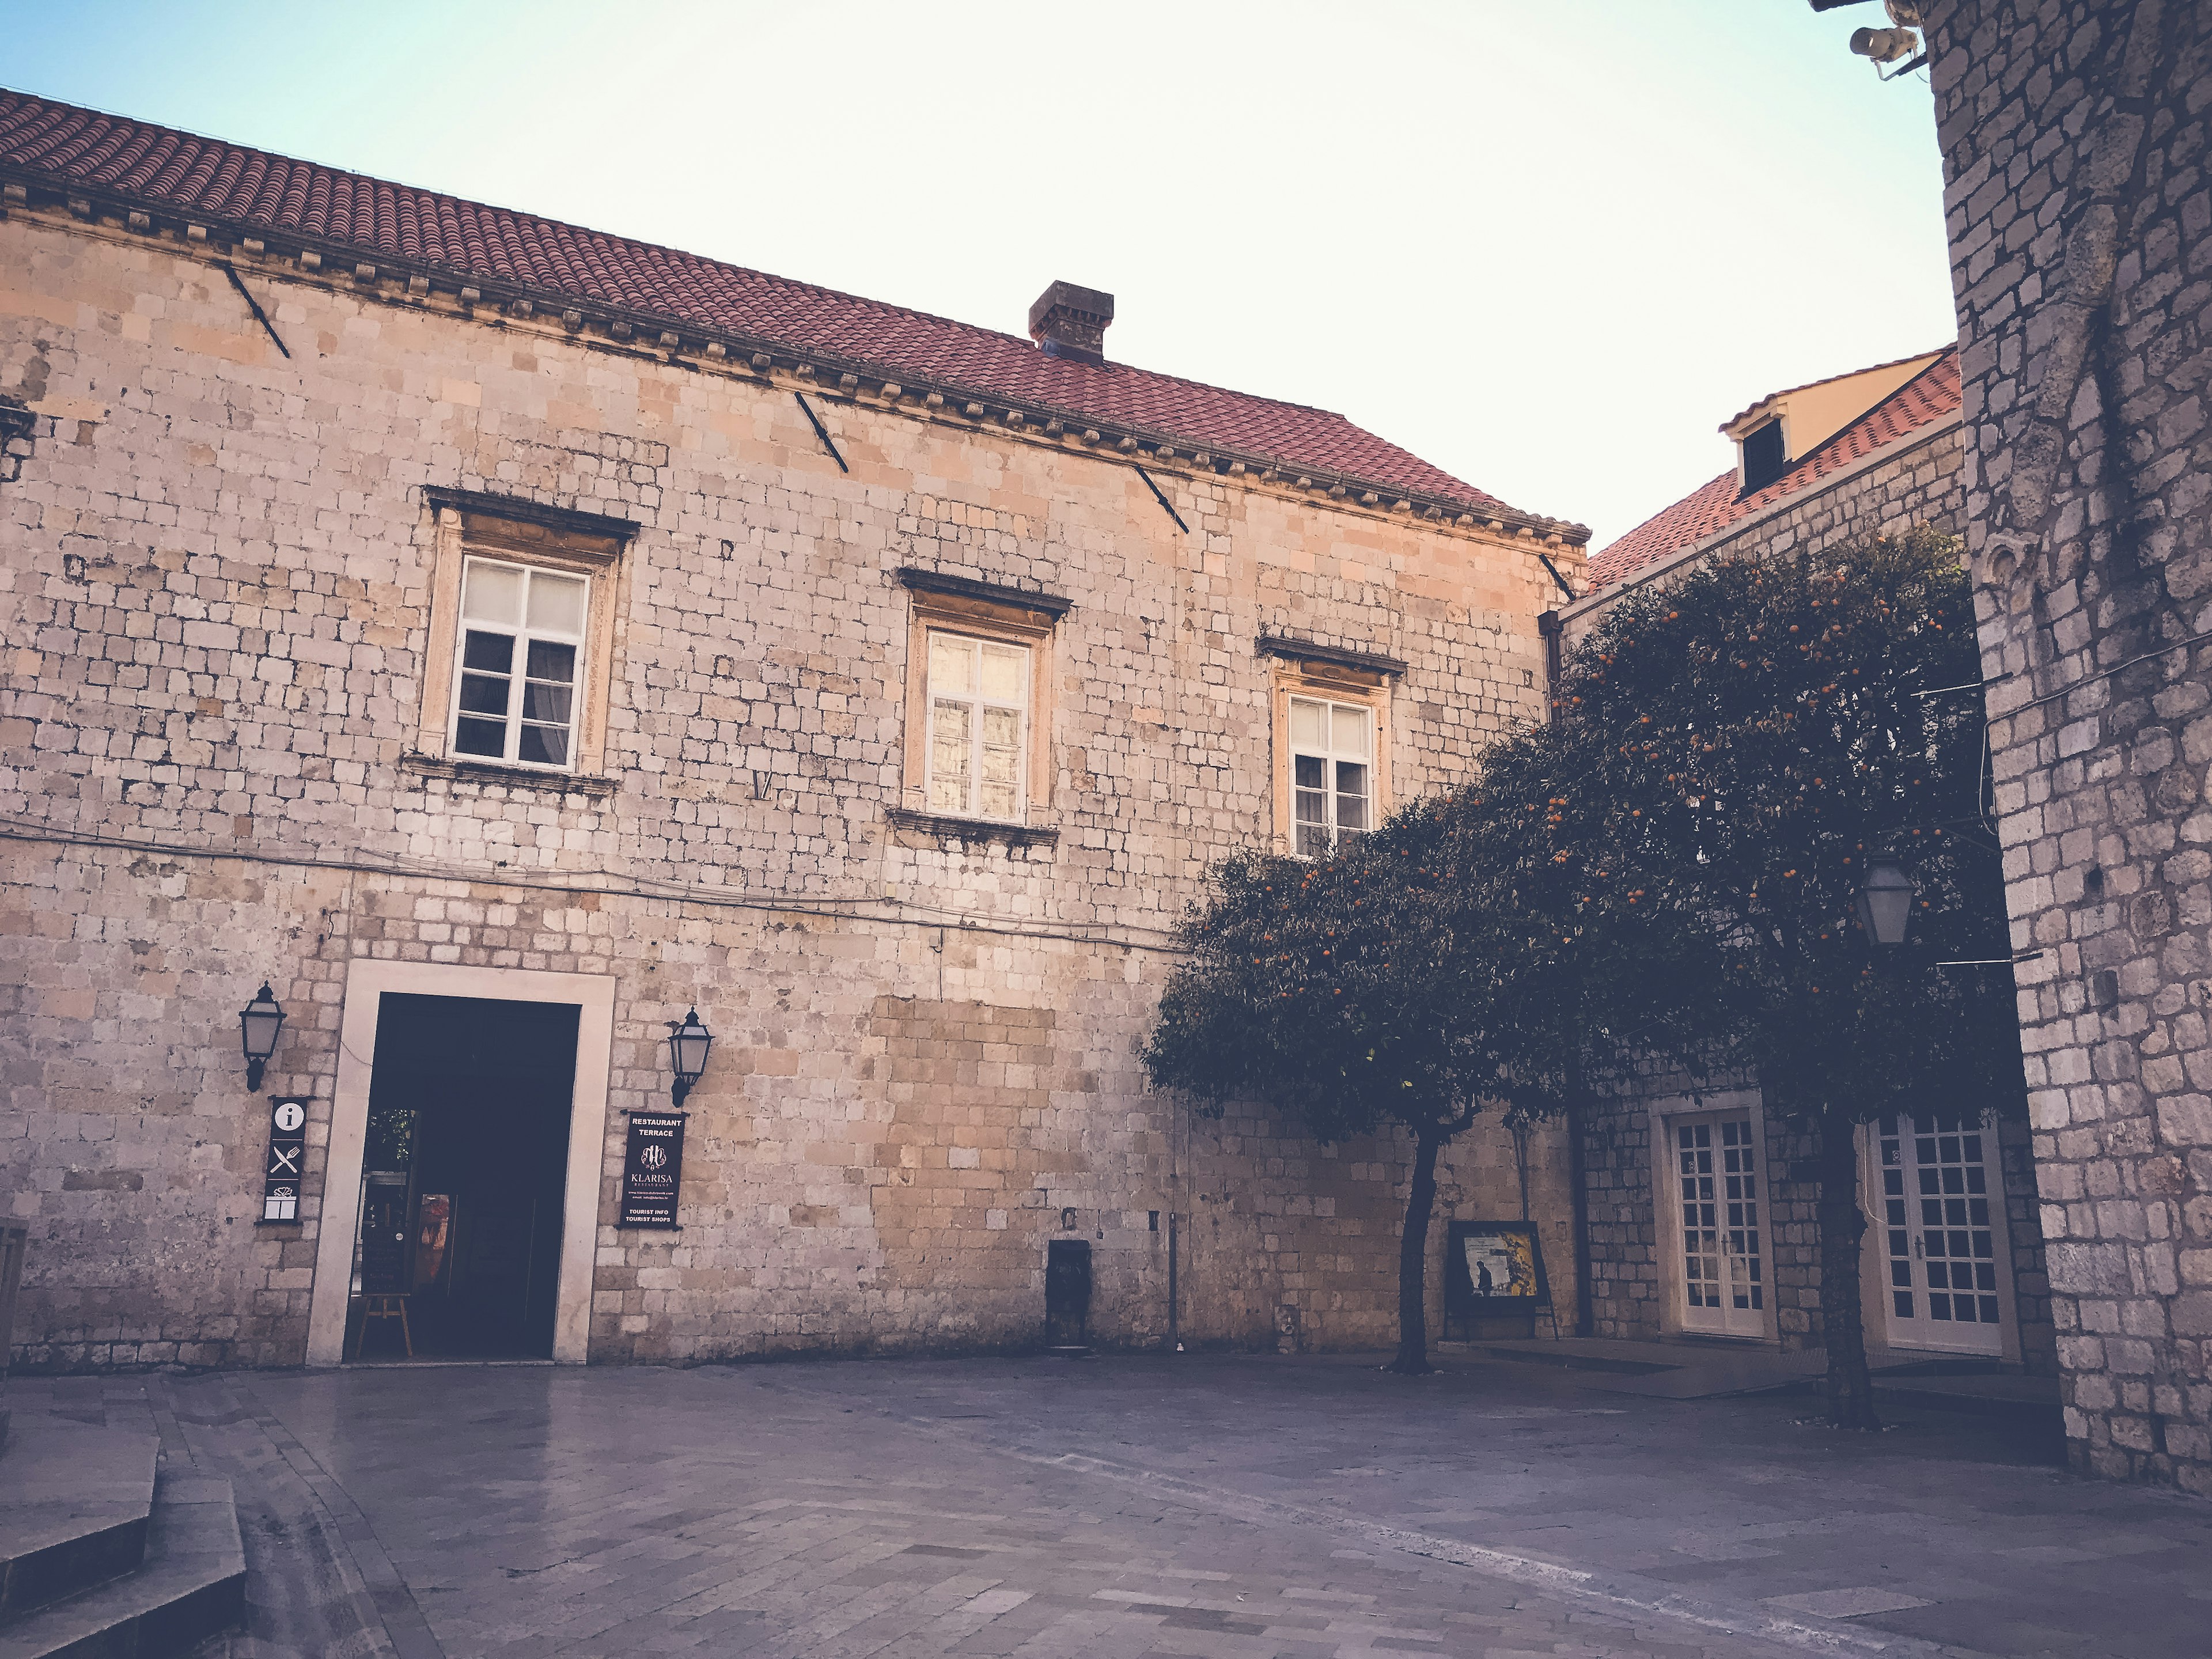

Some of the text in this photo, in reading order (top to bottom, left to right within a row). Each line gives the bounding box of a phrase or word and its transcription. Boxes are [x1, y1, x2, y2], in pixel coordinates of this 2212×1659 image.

[632, 1118, 682, 1126] RESTAURANT
[639, 1129, 673, 1137] TERRACE
[631, 1174, 672, 1183] KLARISA
